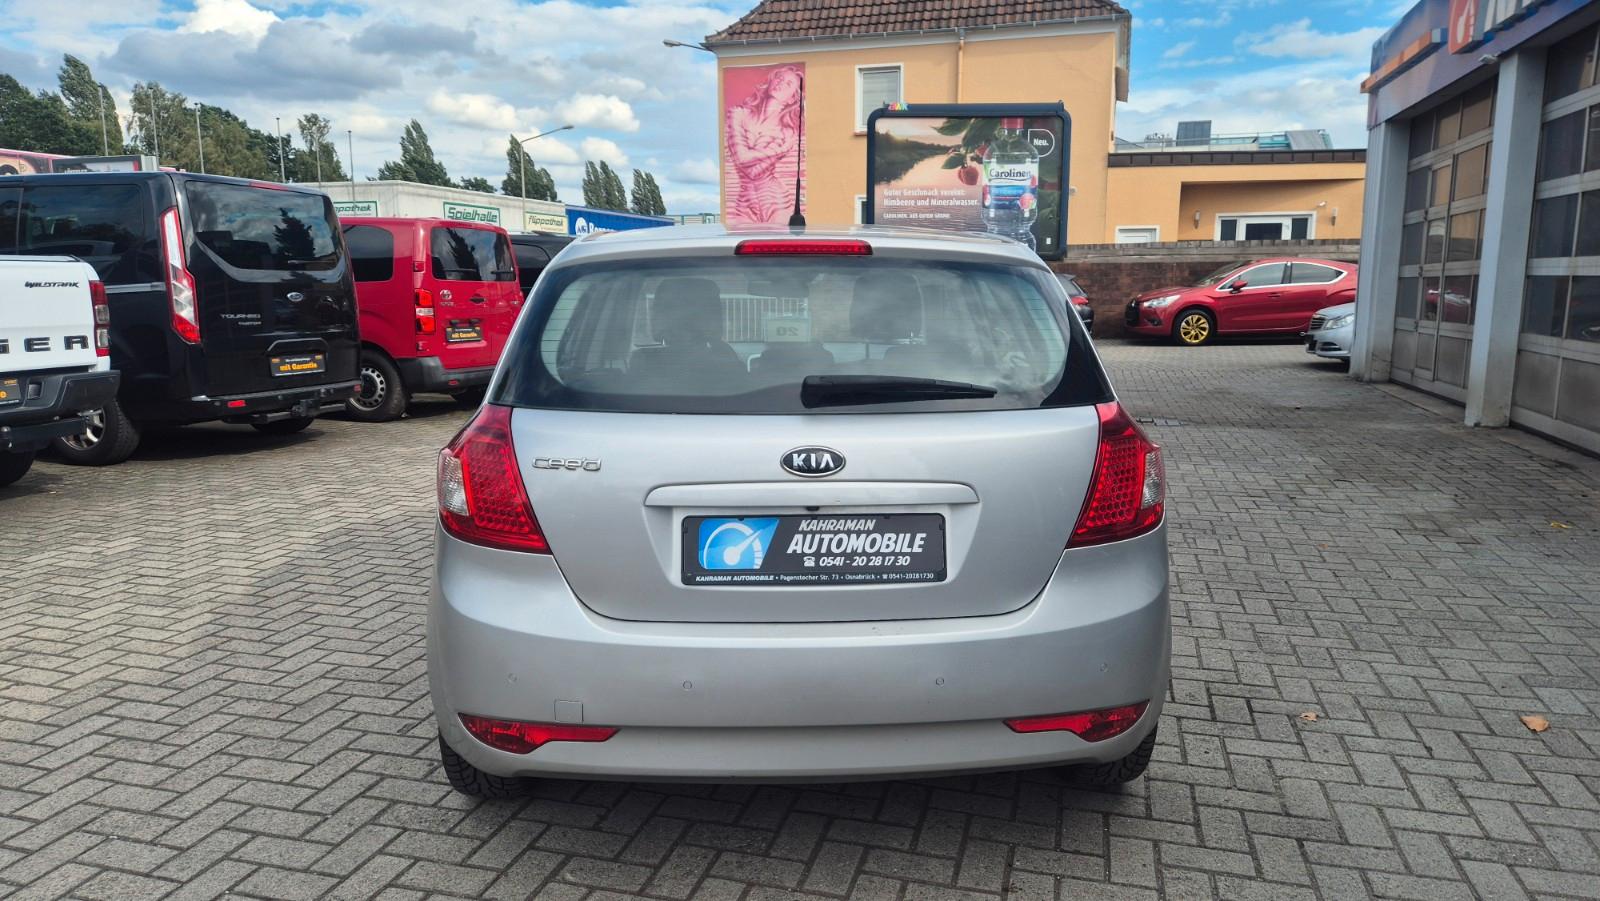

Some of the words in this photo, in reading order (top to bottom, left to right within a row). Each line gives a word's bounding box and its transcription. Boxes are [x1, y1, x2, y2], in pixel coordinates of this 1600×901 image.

[1033, 137, 1049, 147] Neu.
[883, 197, 915, 206] Himbeere
[916, 197, 929, 206] und
[447, 207, 498, 223] Spielhalle
[792, 453, 834, 469] KIA
[798, 519, 876, 531] KAHRAMAN
[786, 533, 927, 554] AUTOMOBILE
[819, 556, 845, 567] 0541
[851, 556, 867, 566] 20
[868, 556, 882, 566] 28
[884, 556, 895, 566] 17
[895, 556, 911, 566] 30
